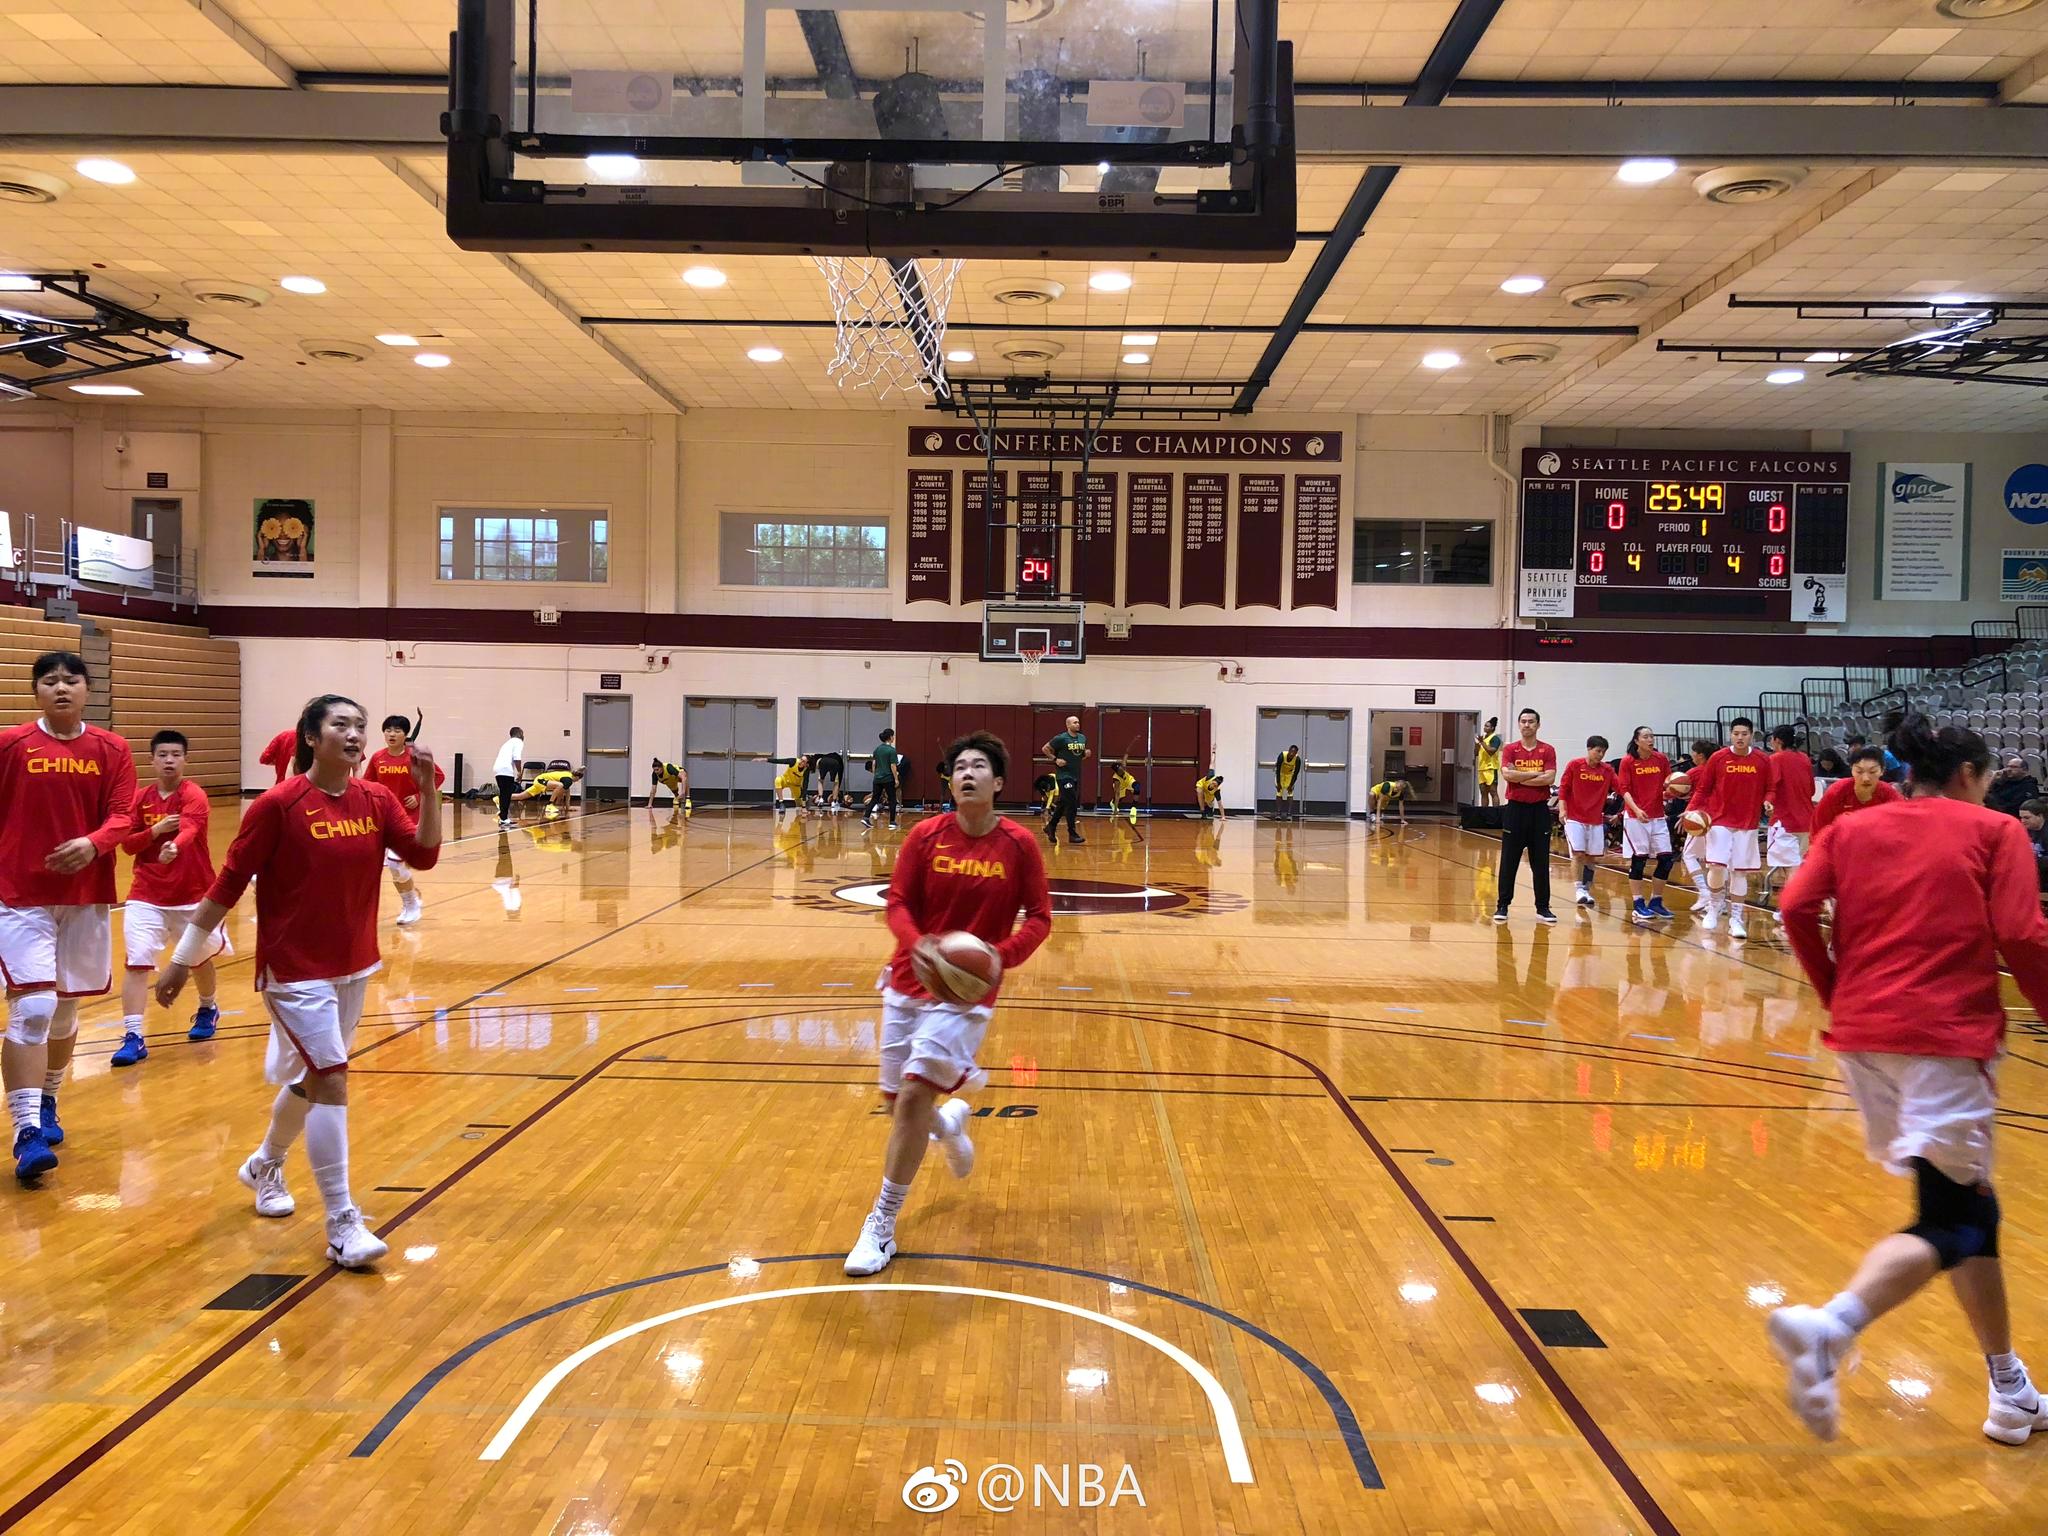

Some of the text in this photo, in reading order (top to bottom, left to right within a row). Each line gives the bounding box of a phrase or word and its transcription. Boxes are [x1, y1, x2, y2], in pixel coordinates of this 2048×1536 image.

[955, 434, 1292, 454] CONFERENCE CHAMPIONS
[1571, 458, 1838, 473] SEATTLE PACIFIC FALCONS
[1595, 487, 1629, 500] HOME
[1748, 490, 1784, 502] GUEST
[1895, 483, 1937, 498] gnac
[1649, 484, 1723, 511] 25:49
[1608, 503, 1625, 530] 0
[1768, 506, 1786, 532] 0
[1658, 522, 1691, 533] PERIOD
[1701, 519, 1707, 537] 1
[1582, 542, 1606, 551] FOULS
[1623, 542, 1646, 552] T.O.L.
[1655, 543, 1713, 553] PLAYER FOUL
[1722, 544, 1745, 554] T.O.L.
[1762, 545, 1786, 555] FOULS
[1590, 552, 1603, 572] 0
[1627, 554, 1641, 572] 4
[1727, 556, 1741, 574] 4
[1769, 555, 1783, 576] 0
[1022, 561, 1048, 581] 24
[1527, 573, 1568, 583] SEATTLE
[1578, 575, 1608, 585] SCORE
[1668, 576, 1699, 586] MATCH
[1758, 578, 1787, 588] SCORE
[1527, 588, 1568, 598] PRINTING
[543, 612, 554, 621] EXIT
[1112, 623, 1124, 633] EXIT
[27, 757, 101, 776] CHINA
[1514, 759, 1544, 767] CHINA
[378, 765, 409, 774] CHINA
[1636, 766, 1661, 775] CHINA
[1726, 765, 1757, 774] CHINA
[1580, 773, 1604, 782] CHINA
[310, 816, 380, 840] CHINA
[932, 855, 1007, 879] CHINA
